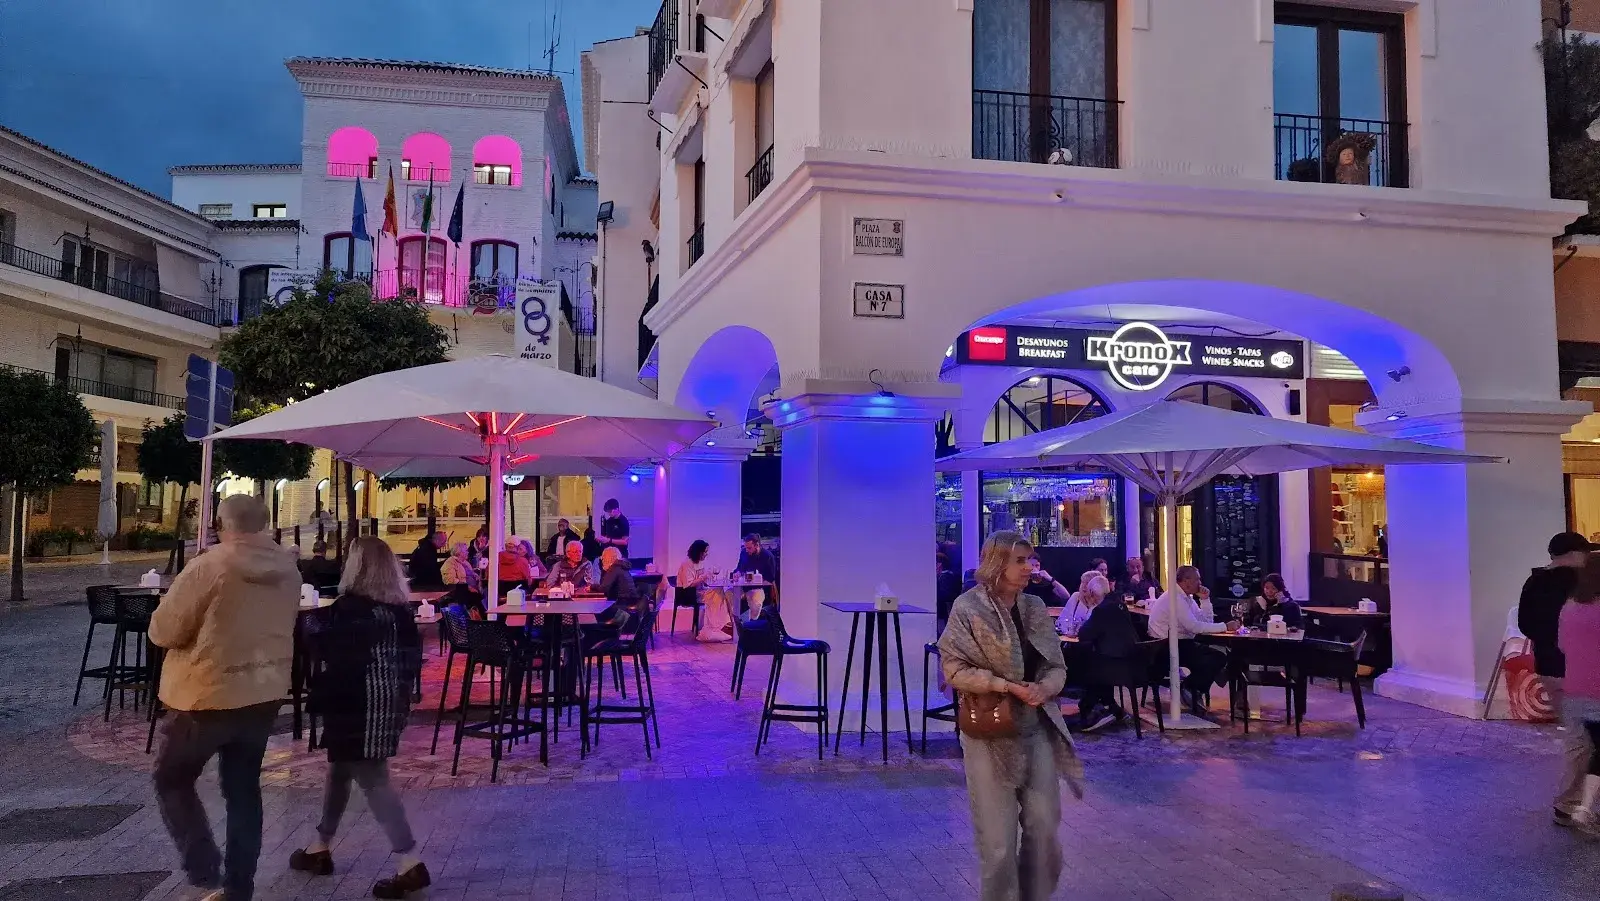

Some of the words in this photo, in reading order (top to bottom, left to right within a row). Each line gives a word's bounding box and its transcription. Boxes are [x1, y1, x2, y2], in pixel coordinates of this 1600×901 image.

[861, 224, 880, 233] PLAZA
[855, 233, 874, 247] BALCÓN
[874, 236, 882, 247] DE
[882, 237, 901, 249] EUROPA
[865, 290, 892, 301] CASA
[881, 302, 887, 311] 7
[525, 342, 536, 352] de
[1016, 336, 1068, 348] DESAYUNOS
[520, 352, 552, 360] marzo
[1018, 347, 1067, 358] BREAKFAST
[1204, 345, 1232, 355] VINOS
[1237, 346, 1262, 357] TAPAS
[1121, 364, 1159, 376] café
